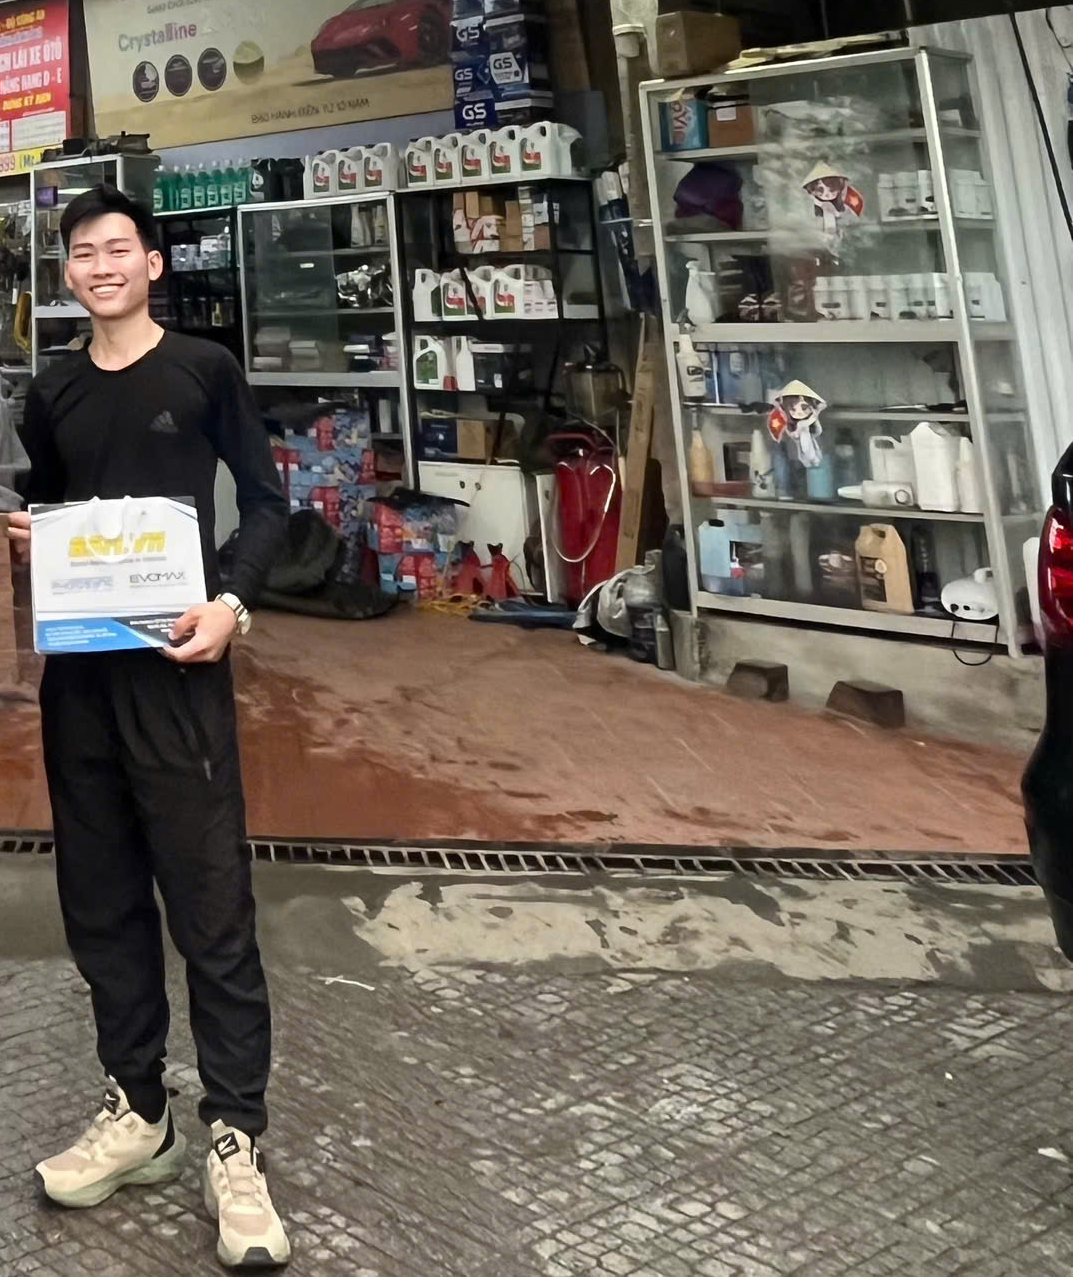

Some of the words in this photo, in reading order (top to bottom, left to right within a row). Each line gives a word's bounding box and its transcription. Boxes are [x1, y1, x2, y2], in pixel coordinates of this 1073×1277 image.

[118, 22, 197, 54] Crystalline
[456, 25, 481, 43] GS
[492, 56, 514, 70] GS
[454, 67, 474, 82] GS
[462, 102, 488, 121] GS
